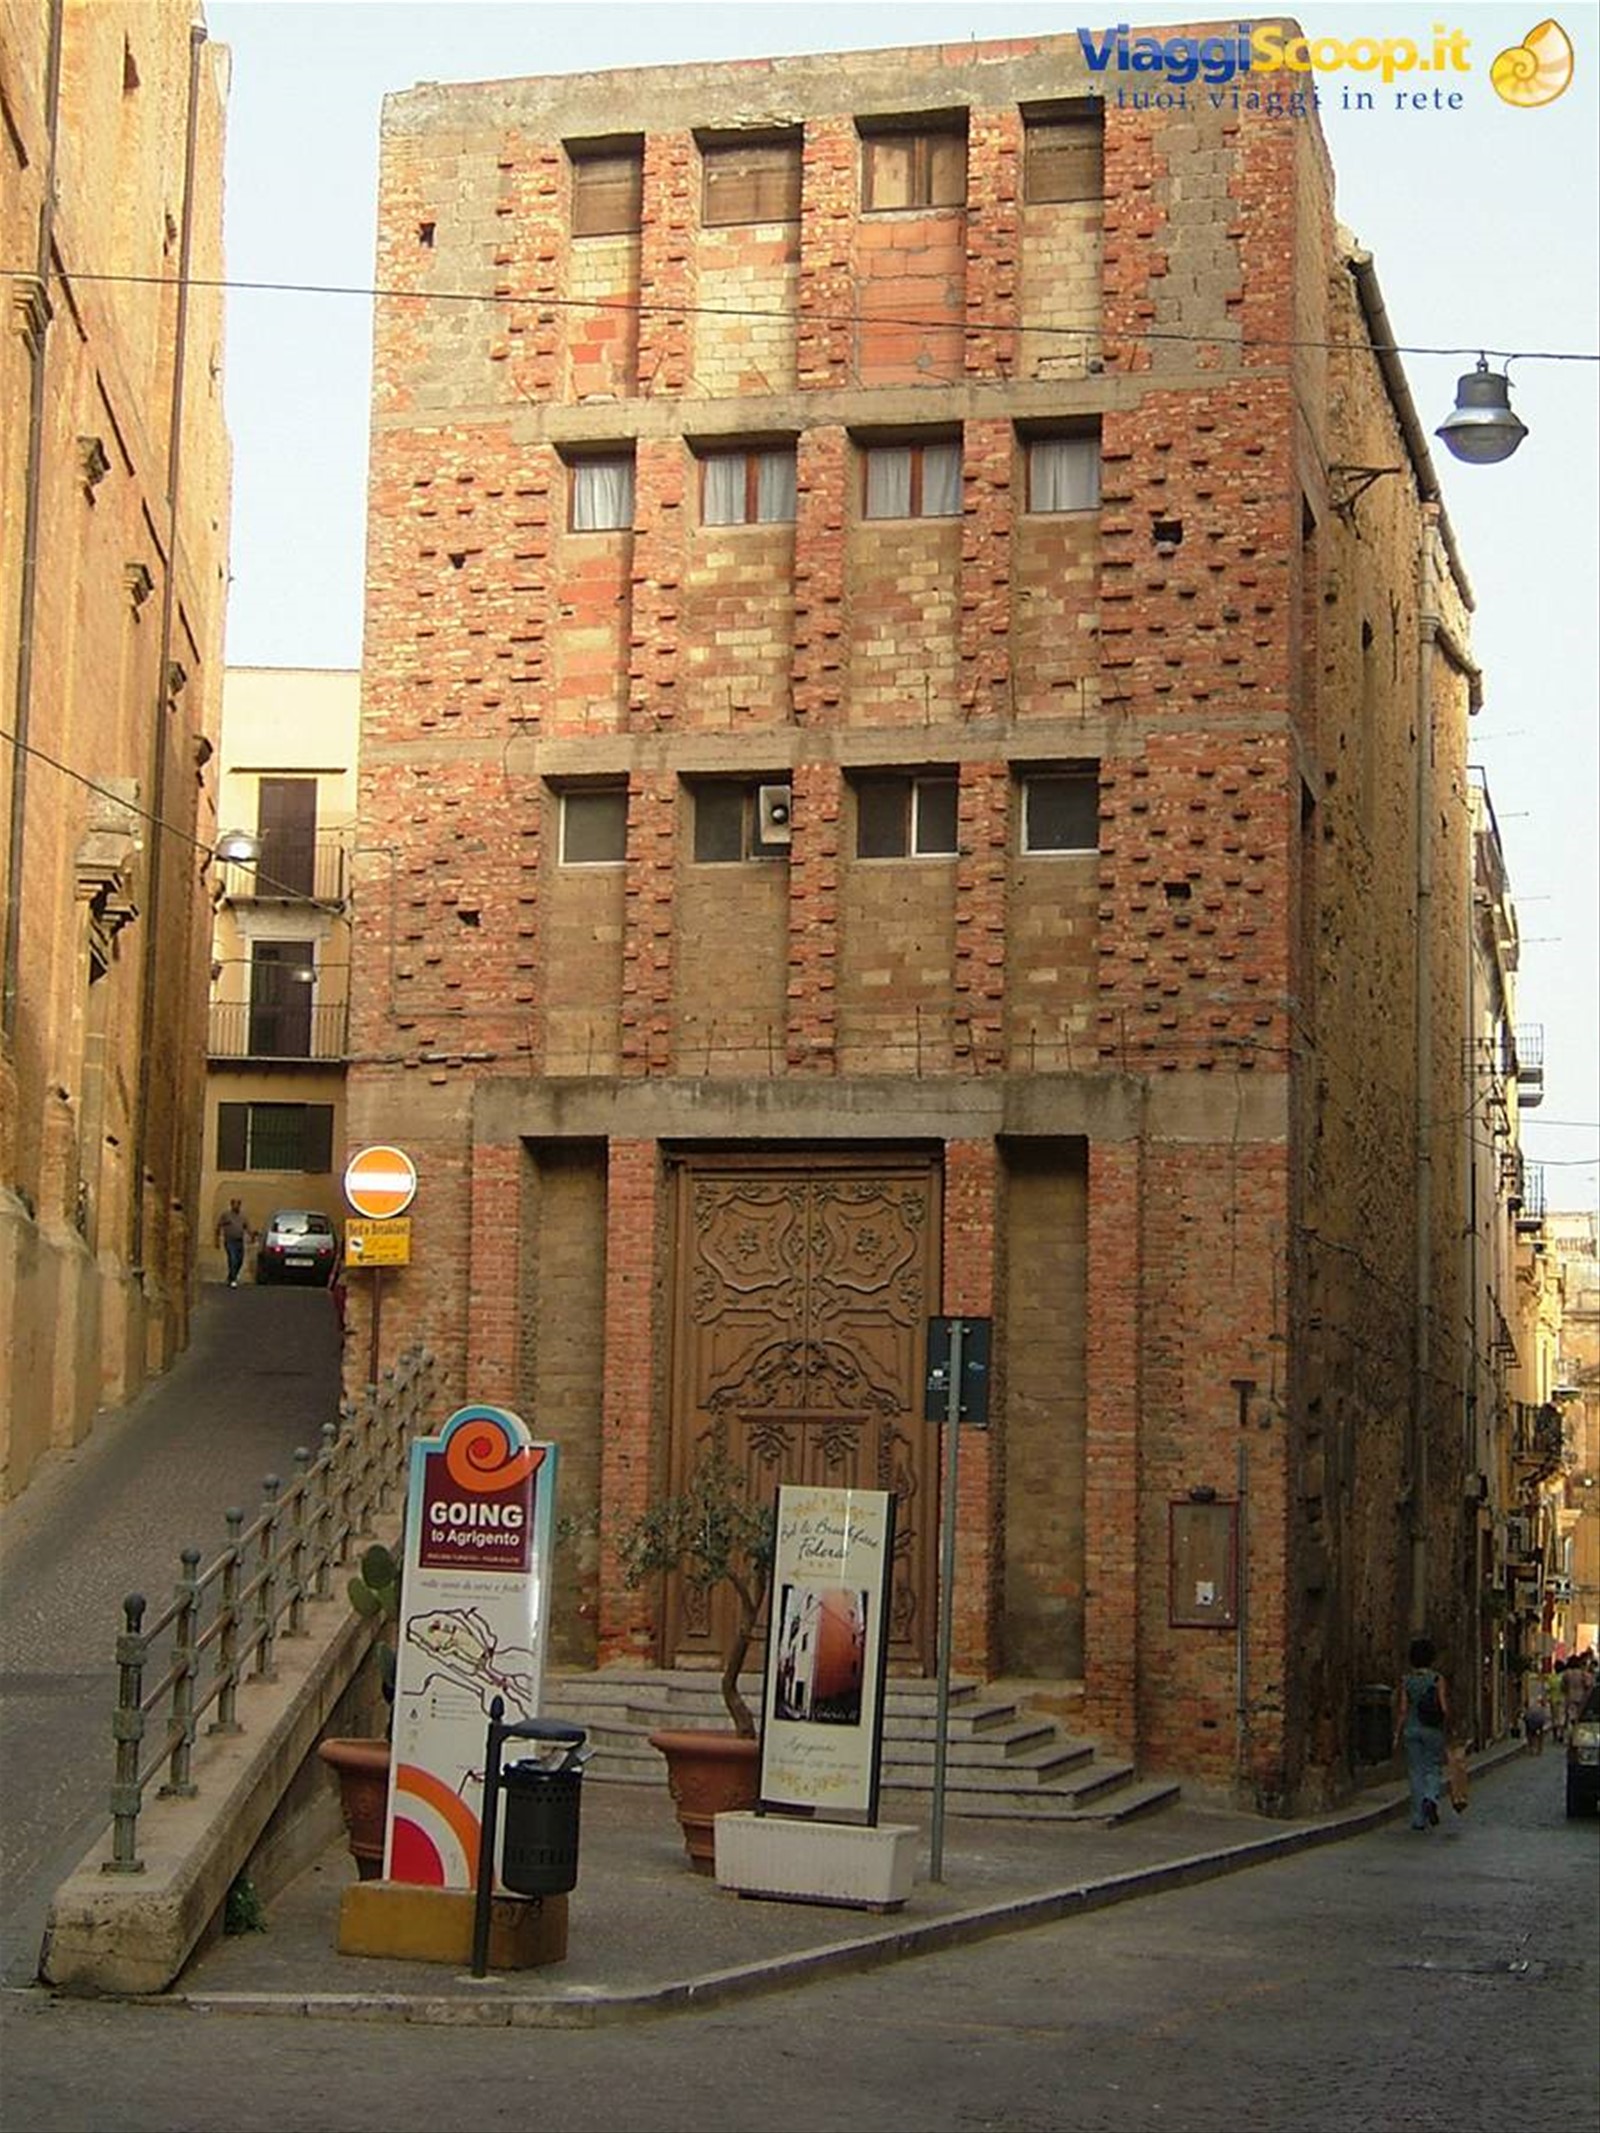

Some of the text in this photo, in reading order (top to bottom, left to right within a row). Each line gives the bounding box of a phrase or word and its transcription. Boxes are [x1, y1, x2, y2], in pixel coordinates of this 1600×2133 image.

[430, 1502, 524, 1528] GOING
[432, 1529, 520, 1547] to Agrigento
